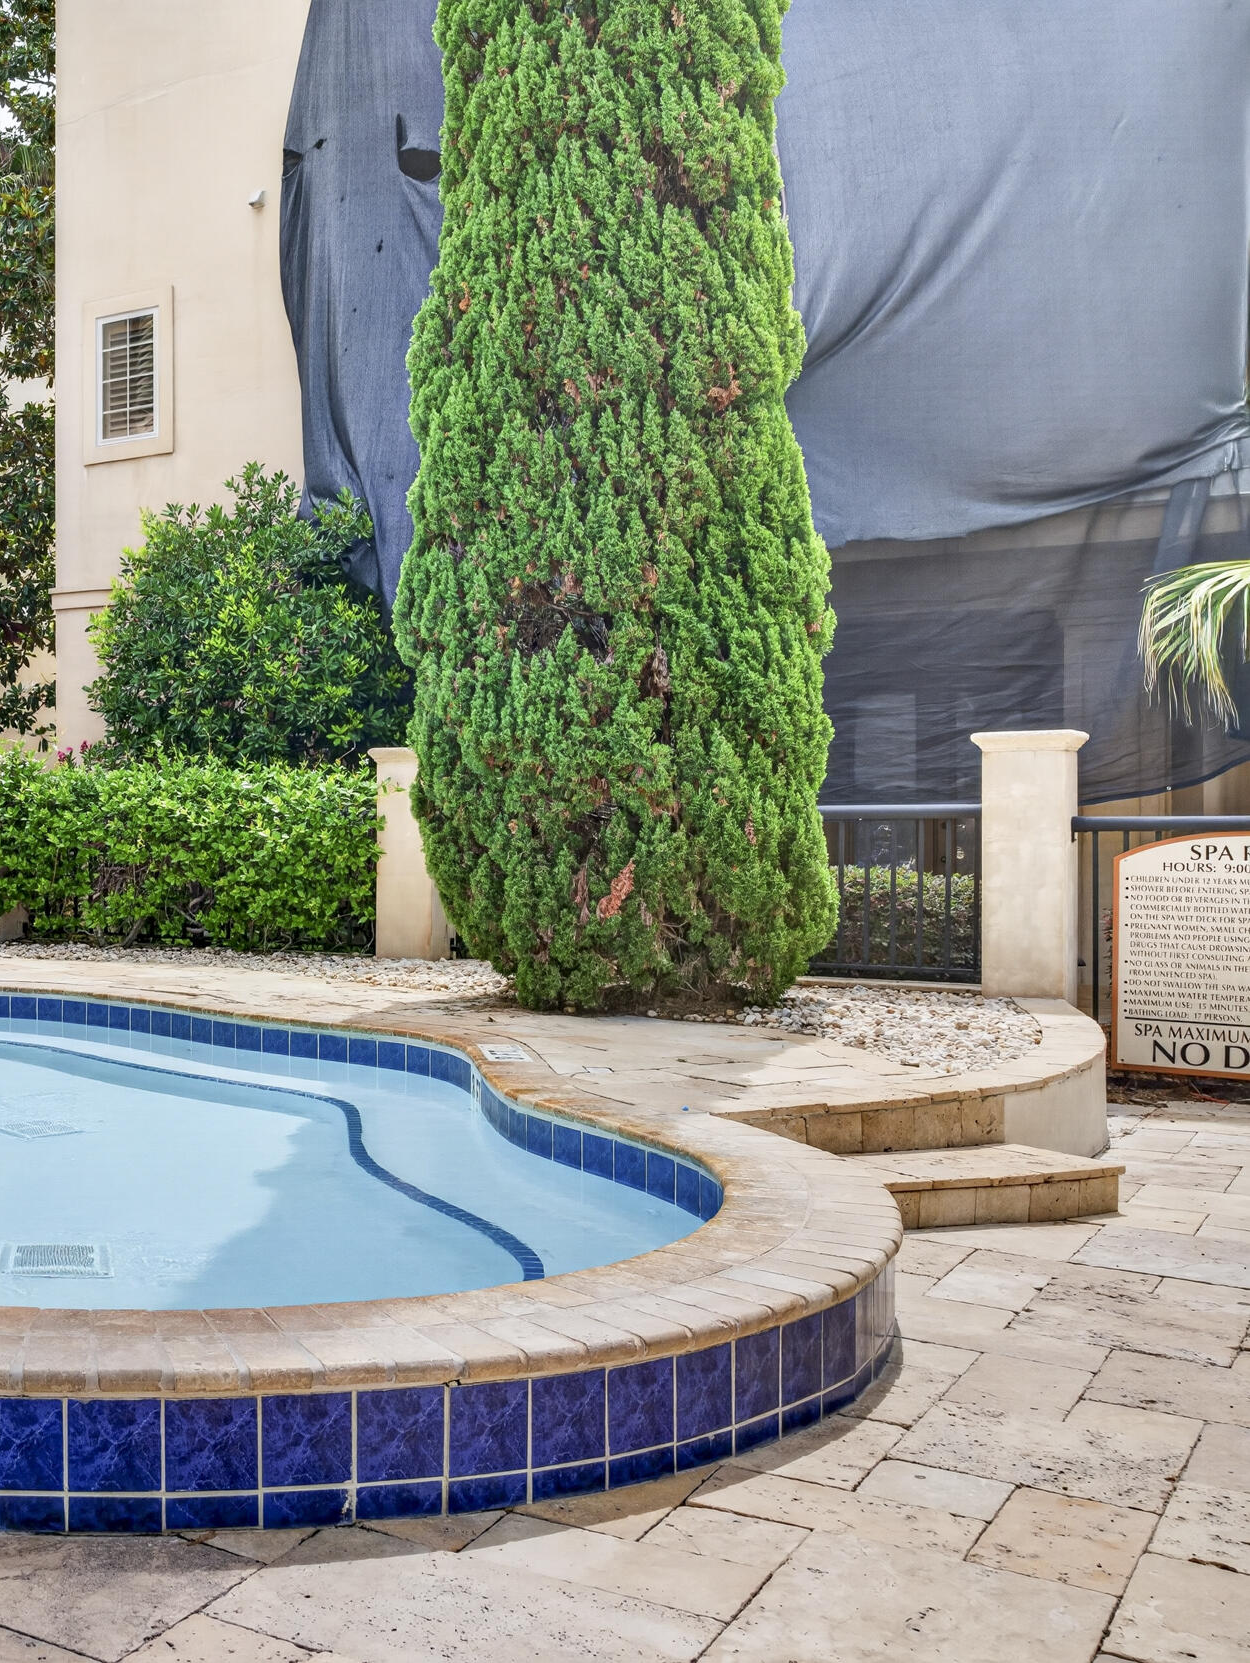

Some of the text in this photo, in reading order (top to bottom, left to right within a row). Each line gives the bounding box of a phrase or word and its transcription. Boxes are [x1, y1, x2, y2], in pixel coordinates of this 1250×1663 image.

[1190, 844, 1234, 861] SPA
[1162, 862, 1217, 873] HOURS:
[1130, 875, 1170, 884] CHILDREN
[1171, 876, 1200, 885] UNDER
[1202, 877, 1211, 885] 12
[1212, 878, 1237, 886] YEARS
[1130, 885, 1164, 893] SHOWER
[1166, 886, 1195, 894] BEFORE
[1197, 887, 1237, 896] ENTERING
[1130, 894, 1144, 902] NO
[1145, 895, 1169, 903] FOOD
[1170, 895, 1183, 903] OR
[1185, 896, 1229, 905] BEVERAGES
[1231, 897, 1240, 905] IN
[1130, 904, 1192, 913] COMMERCIALLY
[1193, 905, 1229, 914] BOTTLED
[1130, 913, 1143, 921] ON
[1144, 913, 1160, 921] THE
[1177, 915, 1194, 923] WET
[1195, 915, 1218, 923] DECK
[1219, 916, 1236, 924] FOR
[1130, 922, 1171, 931] PREGNANT
[1210, 926, 1236, 934] SMALL
[1130, 931, 1250, 944] PROBLEMS AND PEOPLE USING
[1130, 940, 1250, 953] DRUGS THAT CAUSE DROWSIN
[1130, 950, 1168, 959] WITHOUT
[1169, 951, 1190, 960] FIRST
[1191, 952, 1245, 963] CONSULTING
[1129, 959, 1143, 967] NO
[1144, 960, 1169, 969] GLASS
[1170, 961, 1183, 970] OR
[1185, 962, 1221, 972] ANIMALS
[1222, 964, 1232, 972] IN
[1129, 968, 1152, 977] FROM
[1153, 970, 1197, 979] UNFENCED
[1129, 978, 1143, 987] DO
[1144, 979, 1161, 988] NOT
[1162, 980, 1202, 990] SWALLOW
[1204, 982, 1219, 990] THE
[1221, 984, 1236, 992] SPA
[1129, 989, 1175, 998] MAXIMUM
[1177, 991, 1208, 1000] WATER
[1129, 998, 1173, 1007] MAXIMUM
[1174, 1001, 1193, 1009] USE:
[1128, 1008, 1163, 1017] BATHING
[1204, 1013, 1243, 1023] PERSONS.
[1134, 1022, 1163, 1038] SPA
[1152, 1039, 1210, 1067] NO
